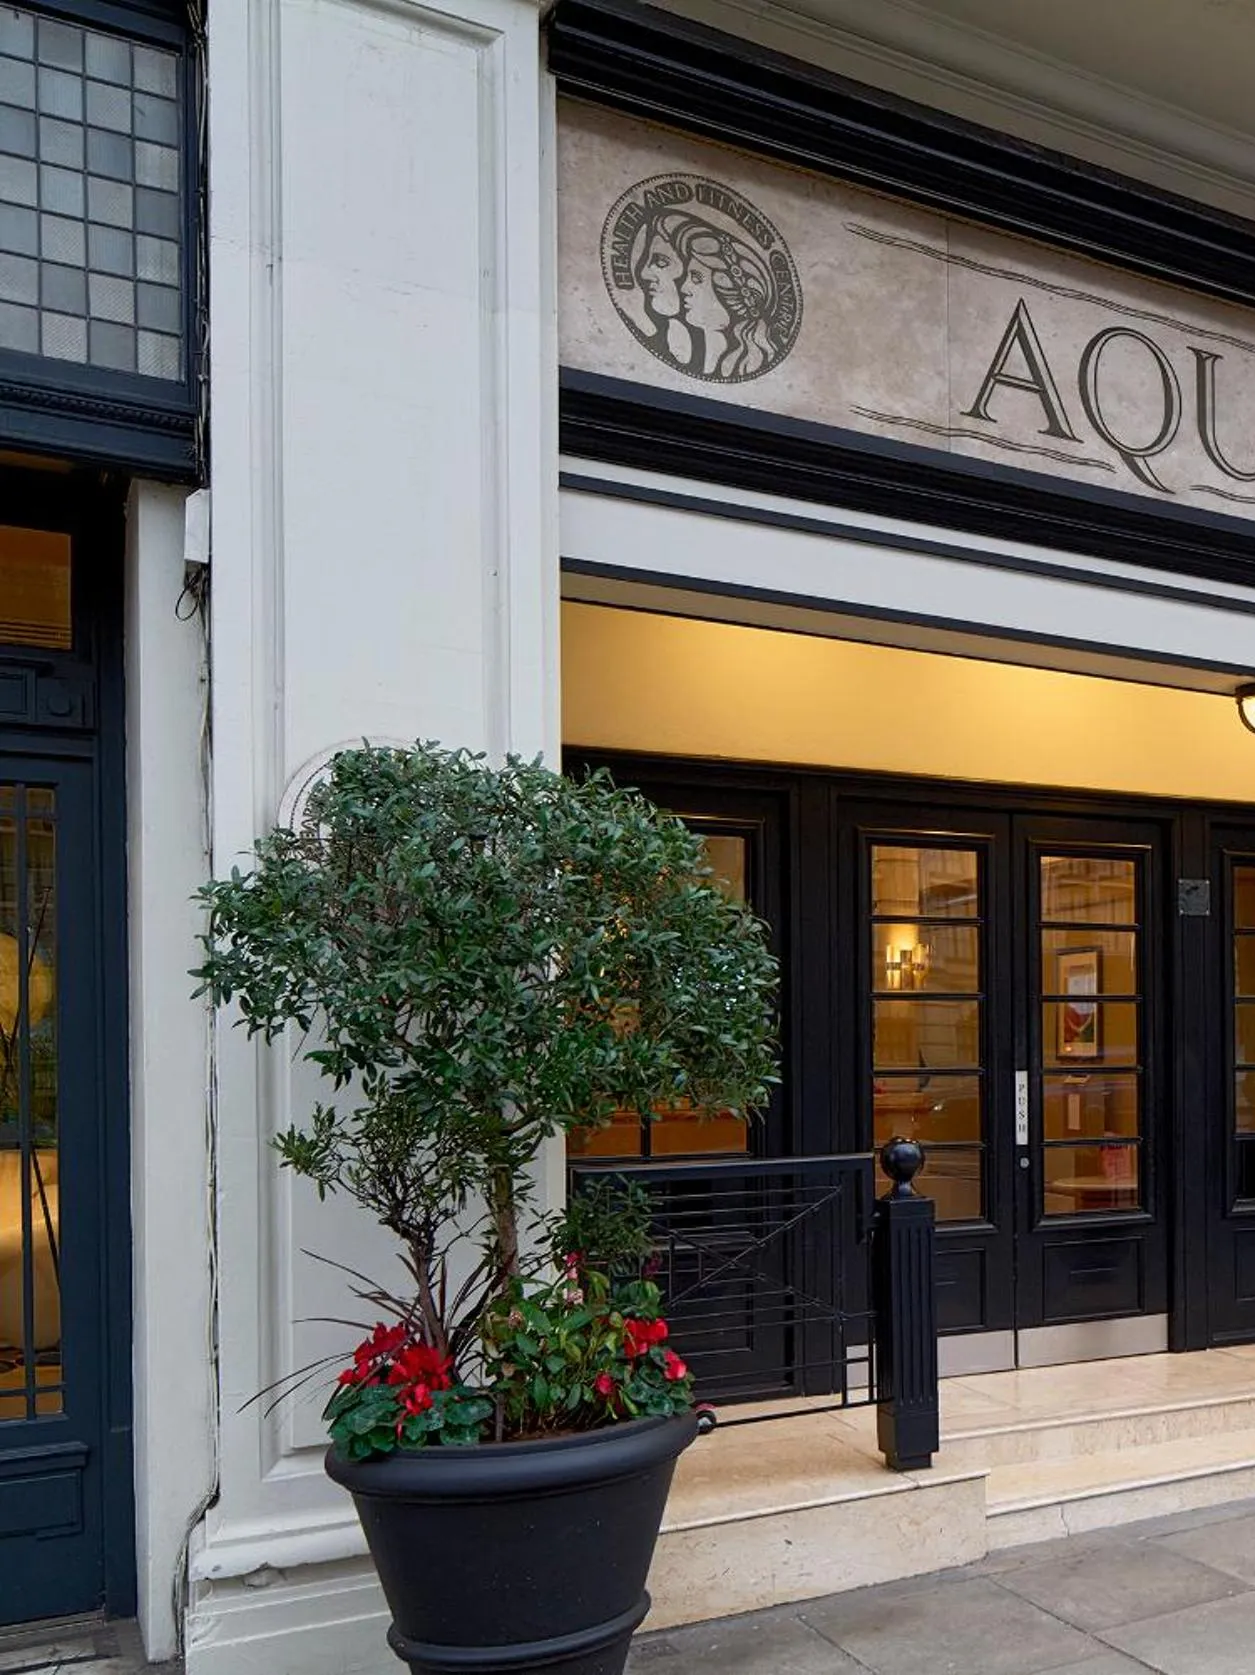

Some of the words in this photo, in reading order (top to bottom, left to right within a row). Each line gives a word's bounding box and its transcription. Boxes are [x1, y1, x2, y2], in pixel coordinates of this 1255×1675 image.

[612, 204, 645, 287] HEALTH
[646, 183, 690, 208] AND
[697, 185, 774, 248] FITNESS
[771, 251, 794, 340] CENTRE
[1018, 1083, 1026, 1133] PUSH
